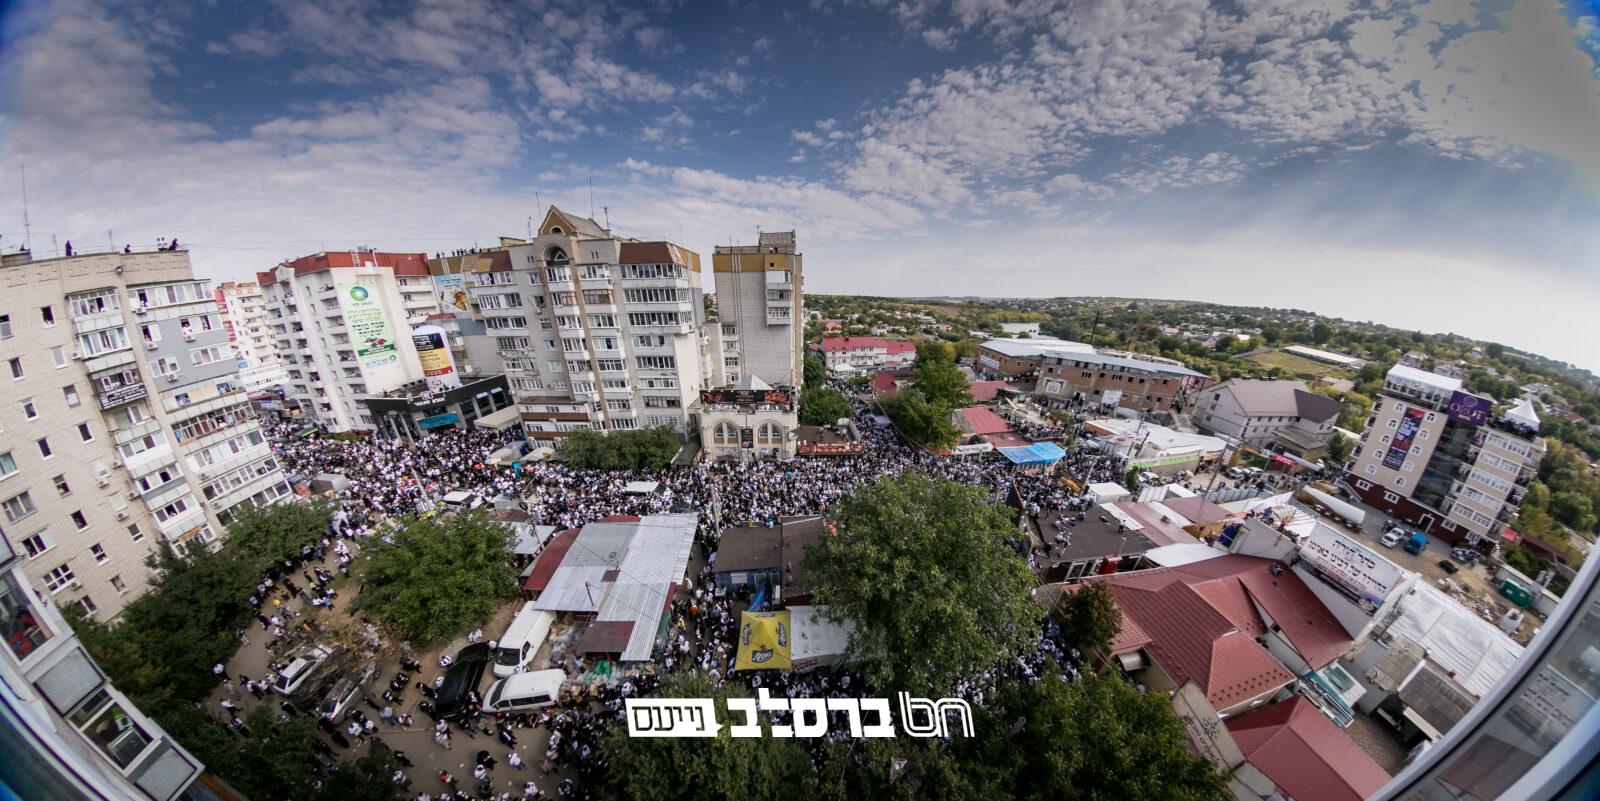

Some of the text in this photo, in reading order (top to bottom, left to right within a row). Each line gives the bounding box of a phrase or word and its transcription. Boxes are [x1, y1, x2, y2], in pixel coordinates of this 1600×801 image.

[1450, 403, 1486, 420] OROT
[1308, 541, 1329, 557] באומן
[1333, 540, 1376, 569] כתר תורה
[1330, 554, 1349, 570] רבינו
[1348, 565, 1361, 577] של
